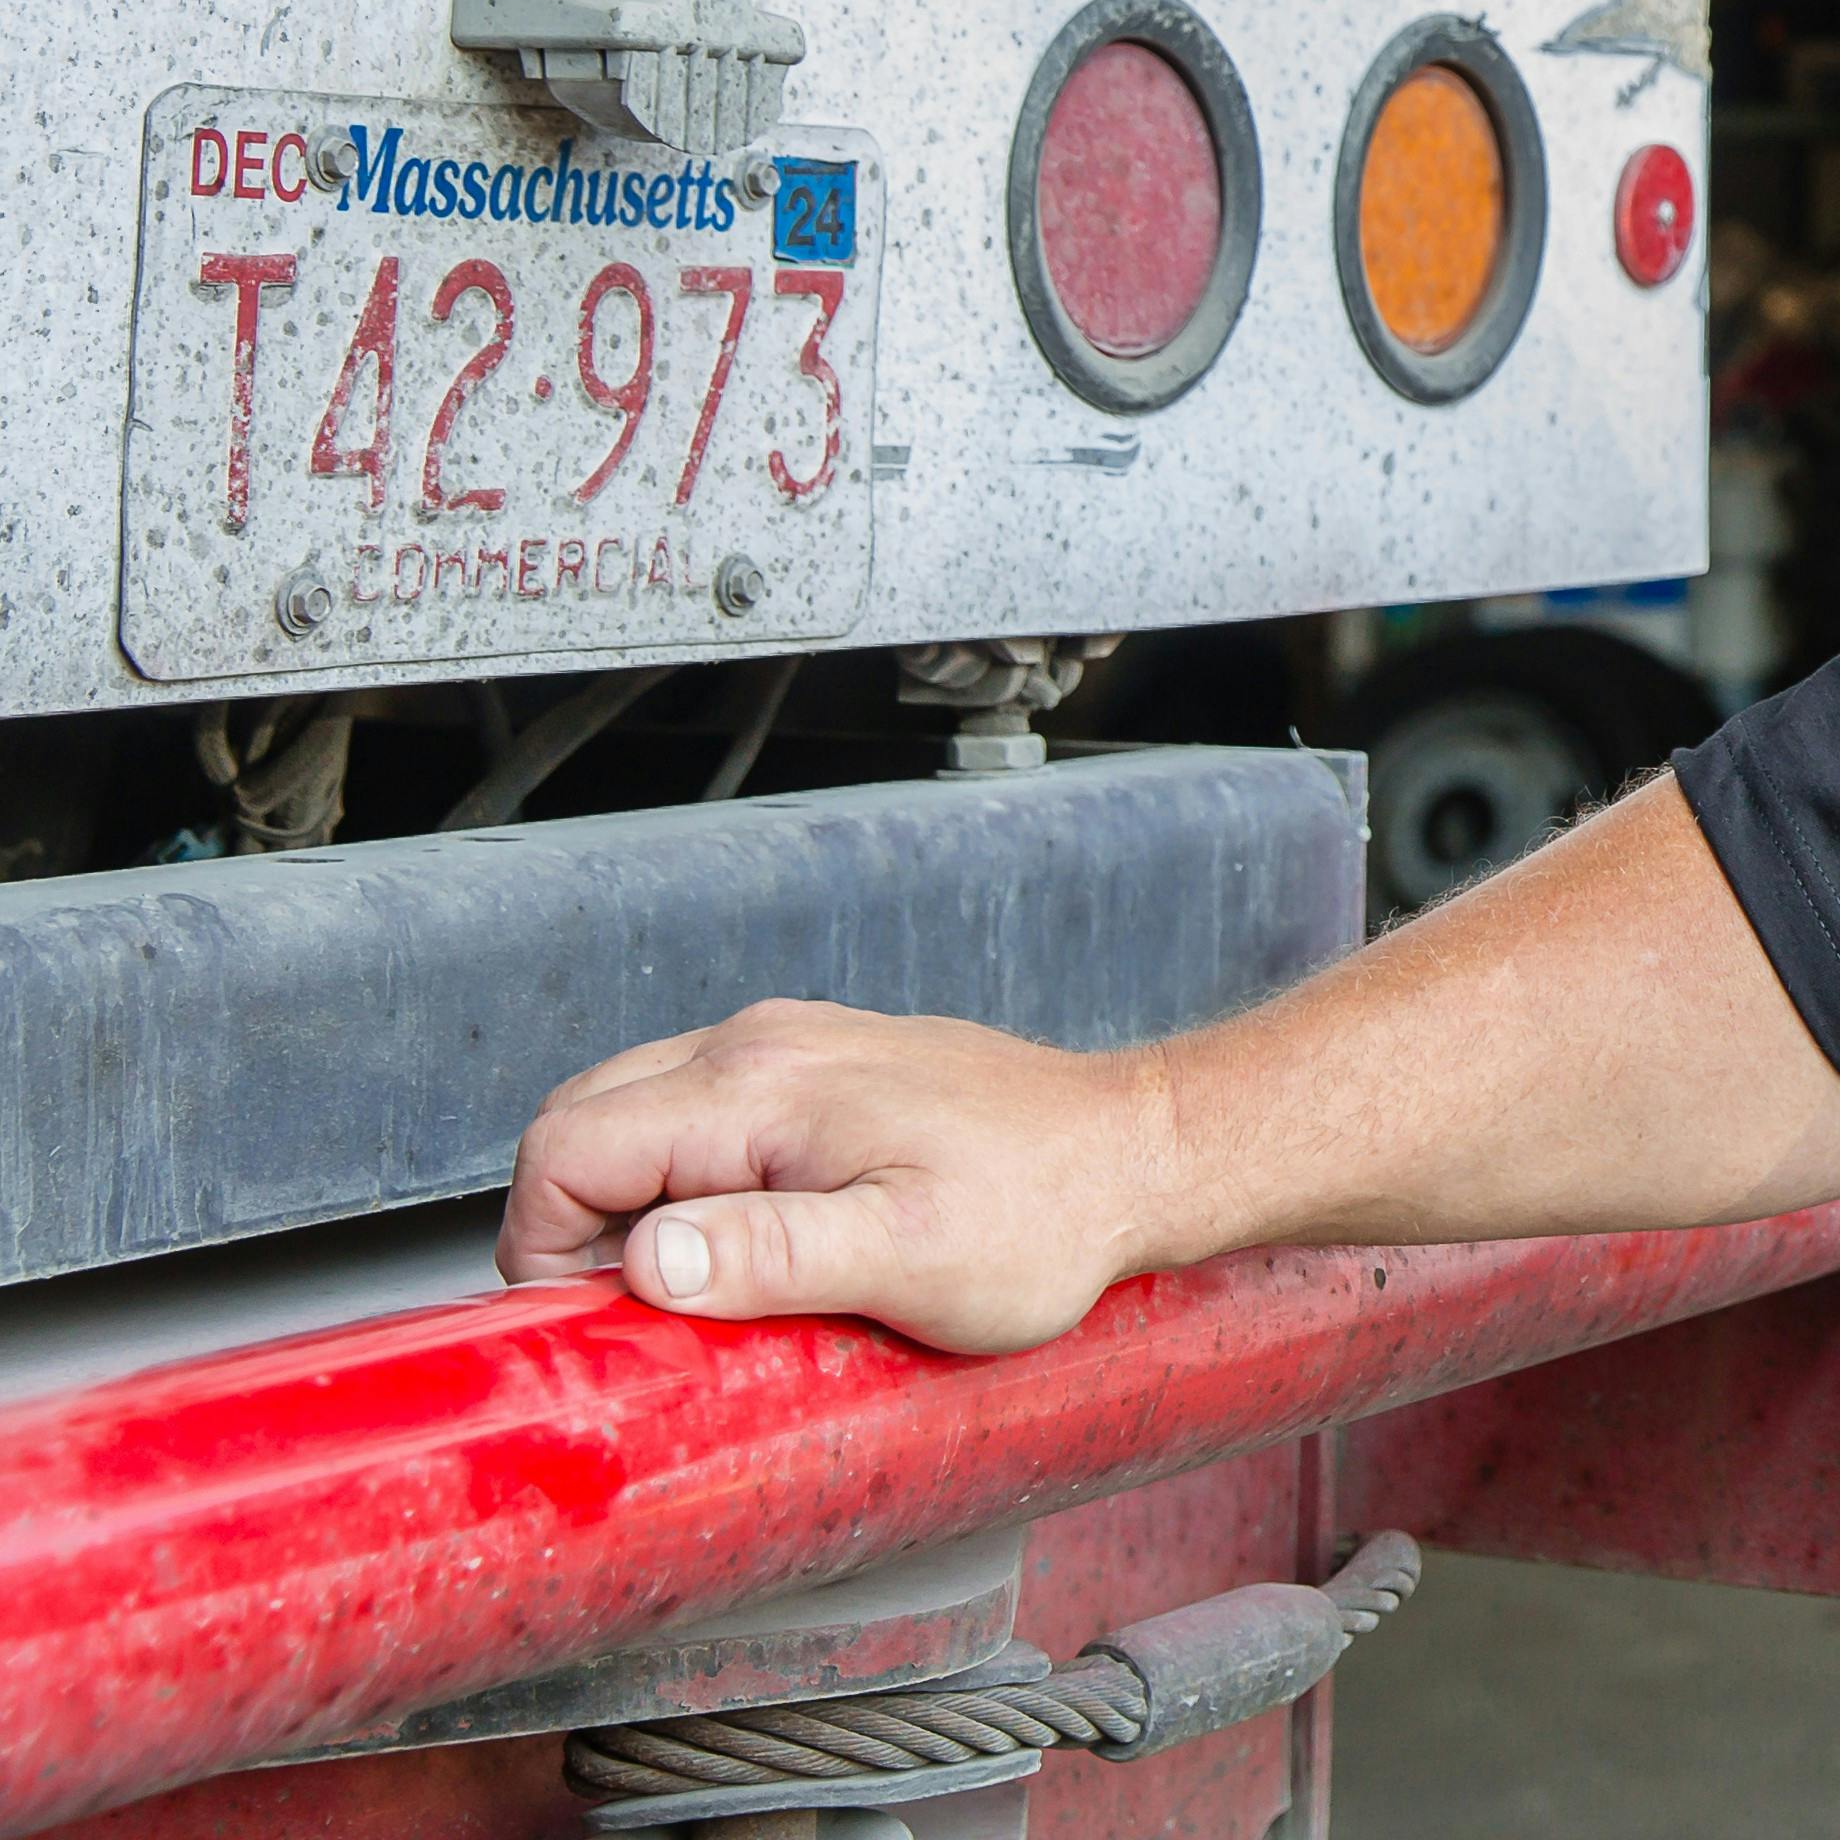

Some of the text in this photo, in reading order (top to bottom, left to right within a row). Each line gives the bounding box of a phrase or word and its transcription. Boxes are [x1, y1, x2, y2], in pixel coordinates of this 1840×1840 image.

[190, 127, 308, 203] DEC
[336, 124, 736, 233] Massachusetts
[784, 186, 846, 247] 24
[352, 536, 708, 602] COMMERCIAL
